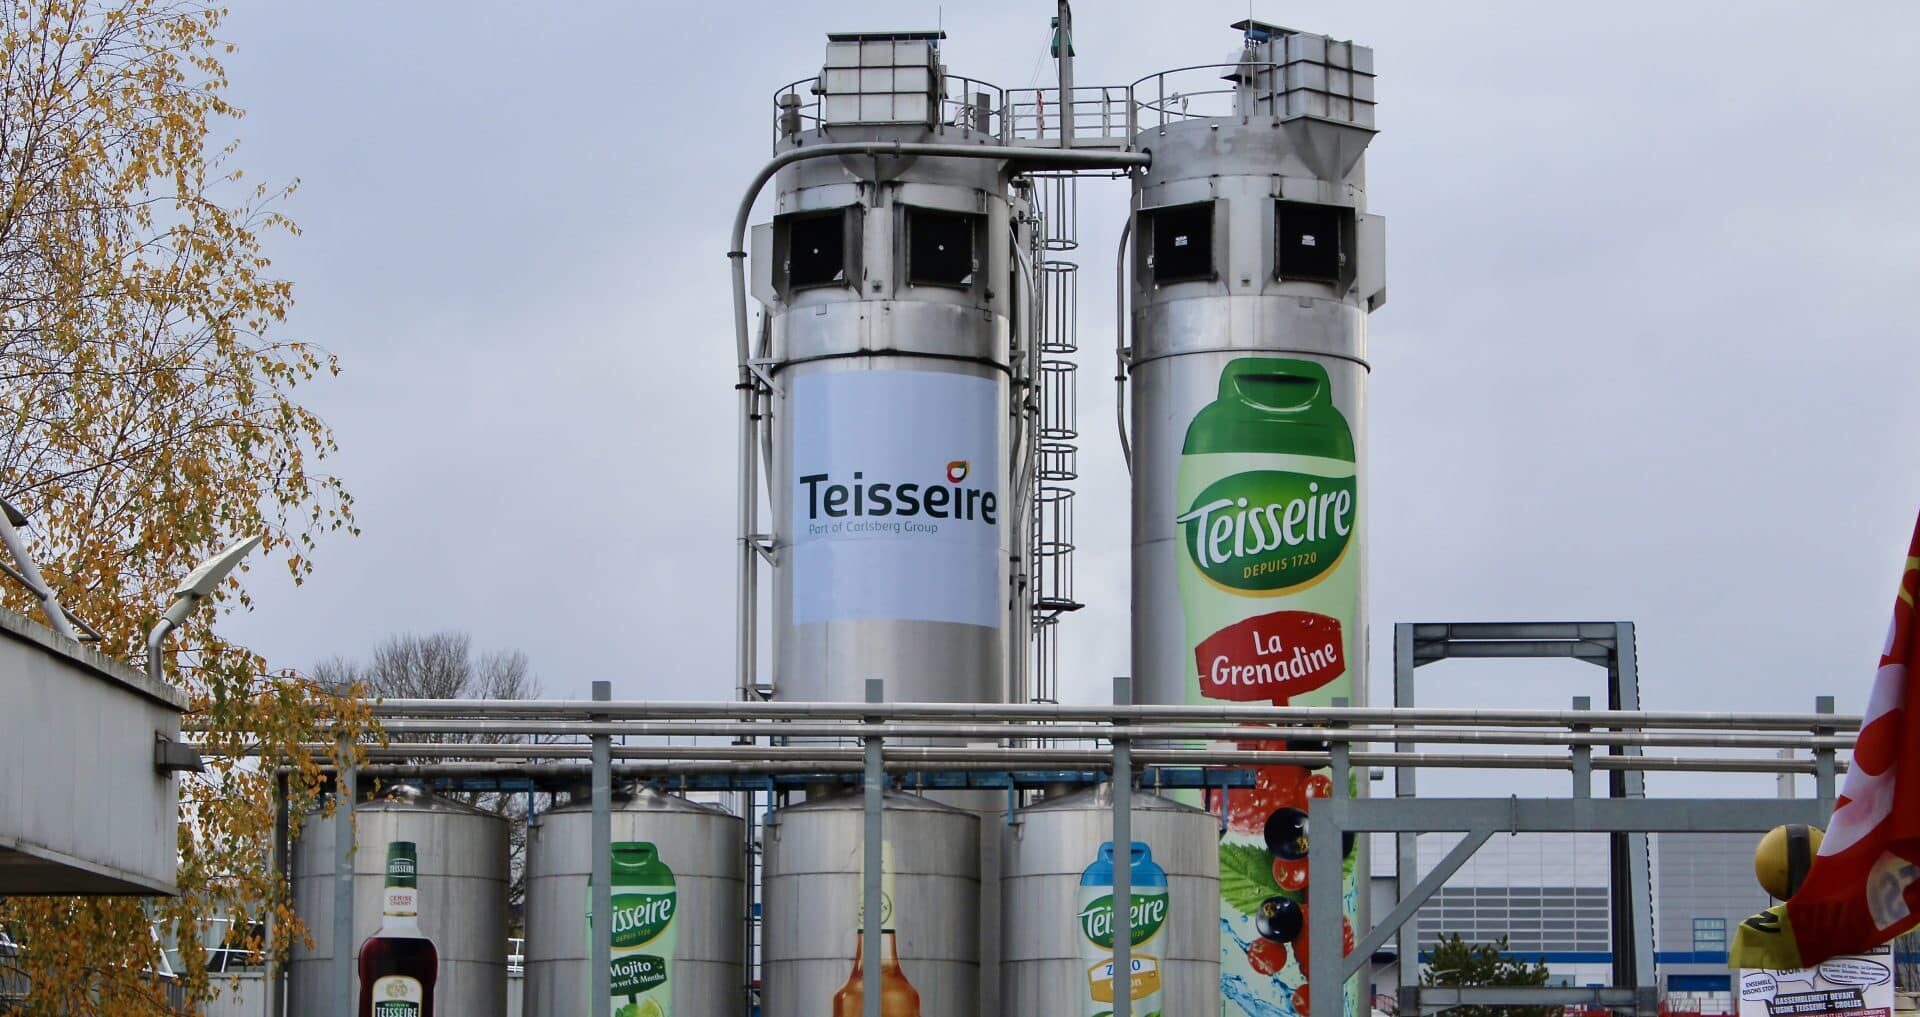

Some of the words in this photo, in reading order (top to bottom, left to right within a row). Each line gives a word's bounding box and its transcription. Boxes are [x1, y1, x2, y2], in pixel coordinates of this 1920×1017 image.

[800, 471, 997, 525] Teisseire
[809, 523, 828, 535] Part
[832, 522, 842, 533] of
[847, 520, 900, 534] Carlsberg
[904, 520, 938, 535] Group
[1176, 482, 1351, 569] Teisseire
[1243, 557, 1288, 579] DEPUIS
[1292, 552, 1317, 568] 1720
[1253, 630, 1283, 656] La
[1211, 642, 1337, 686] Grenadine
[610, 961, 652, 978] Mojito
[1830, 991, 1855, 1000] DEVANT
